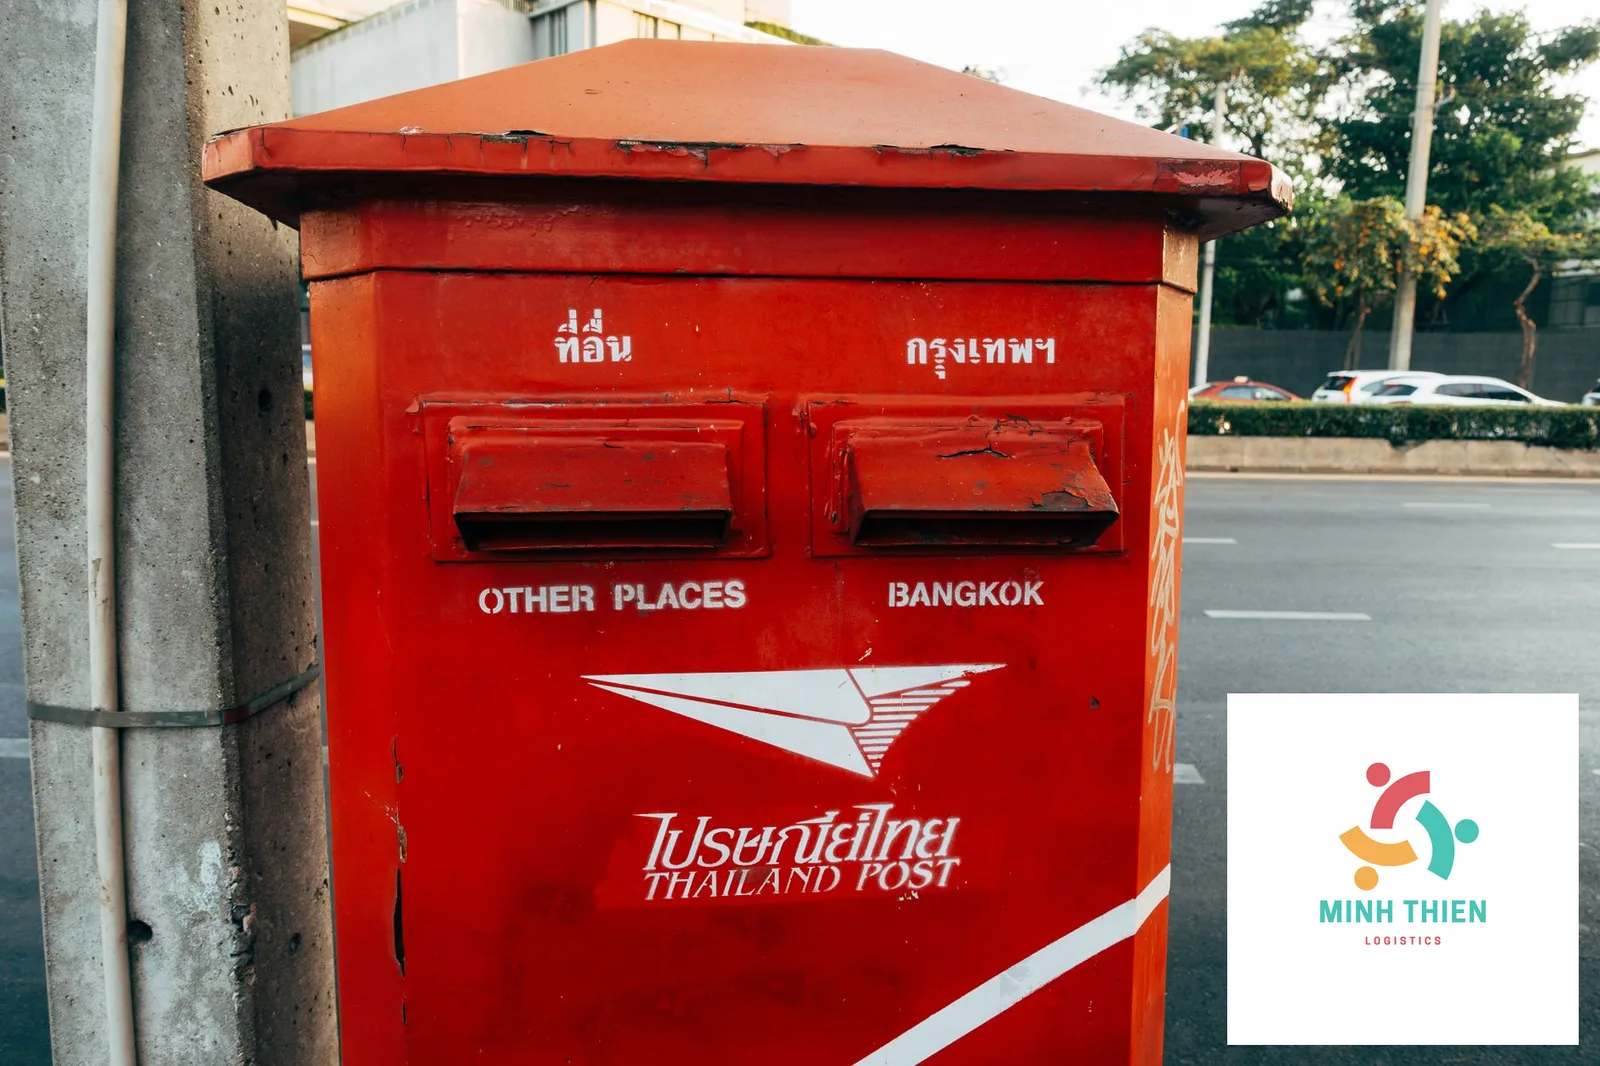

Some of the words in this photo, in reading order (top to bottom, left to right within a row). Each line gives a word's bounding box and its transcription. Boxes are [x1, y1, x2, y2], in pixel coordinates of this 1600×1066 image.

[554, 308, 632, 363] ที่อื่น
[906, 337, 1055, 379] กรุงเทพฯ
[478, 585, 595, 613] OTHER
[614, 581, 747, 611] PLACES
[888, 581, 1045, 607] BANGKOK
[633, 803, 961, 871] ไปรษณีย์ไทย
[643, 865, 841, 900] THAILAND
[855, 859, 961, 891] POST
